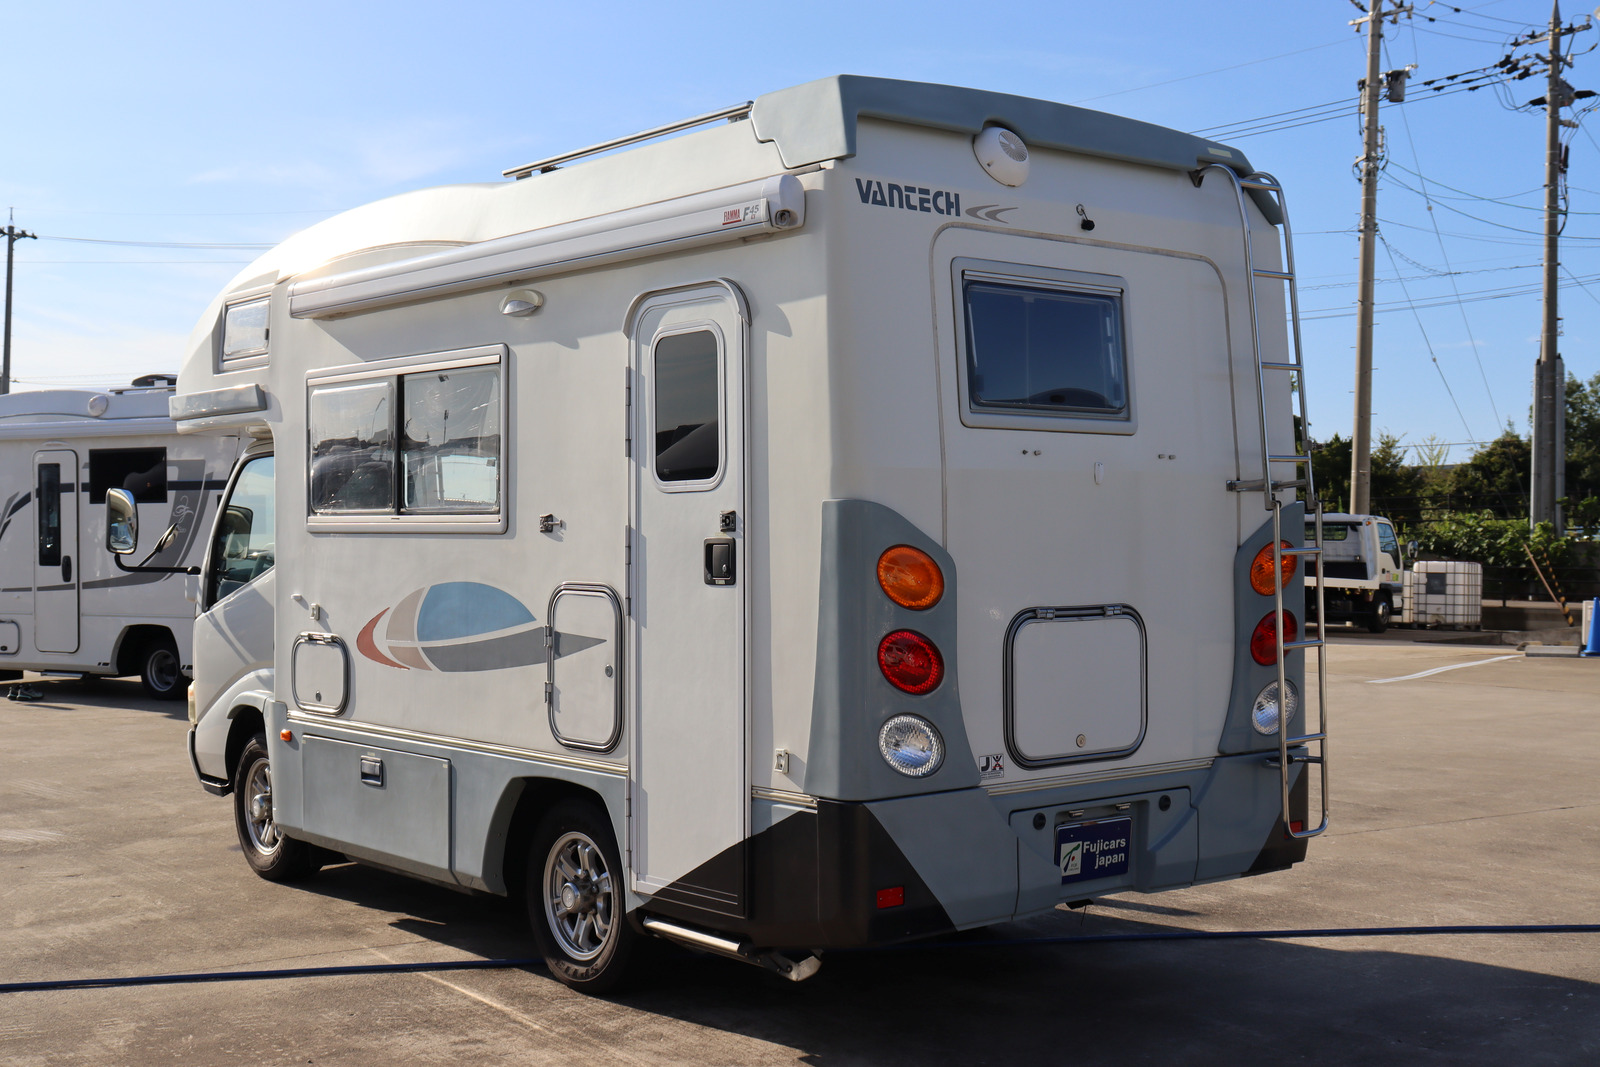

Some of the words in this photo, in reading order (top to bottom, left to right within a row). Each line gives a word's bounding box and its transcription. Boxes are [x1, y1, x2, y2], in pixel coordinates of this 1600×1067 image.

[855, 178, 961, 217] VANTECH
[1083, 838, 1126, 854] Fujicars
[1094, 852, 1125, 870] japan
